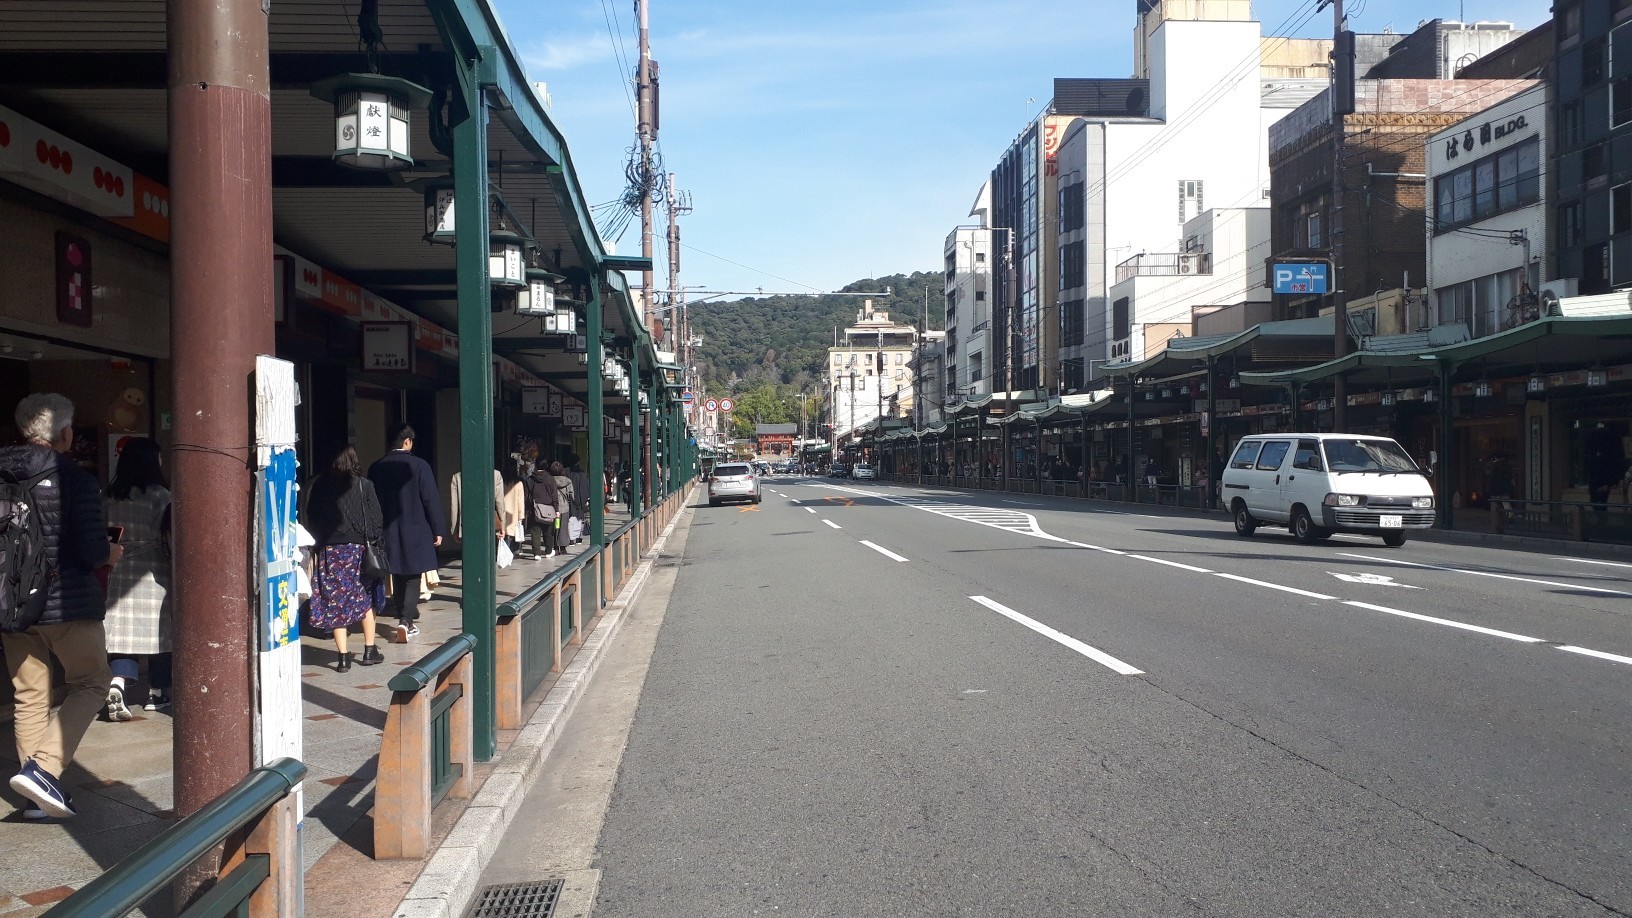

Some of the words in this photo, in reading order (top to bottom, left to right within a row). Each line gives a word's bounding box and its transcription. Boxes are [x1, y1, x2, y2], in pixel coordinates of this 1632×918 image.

[1494, 115, 1529, 140] BLDG.
[1045, 125, 1059, 176] フジビル
[1276, 269, 1293, 289] P
[1291, 283, 1307, 292] 市営
[722, 401, 730, 409] 40
